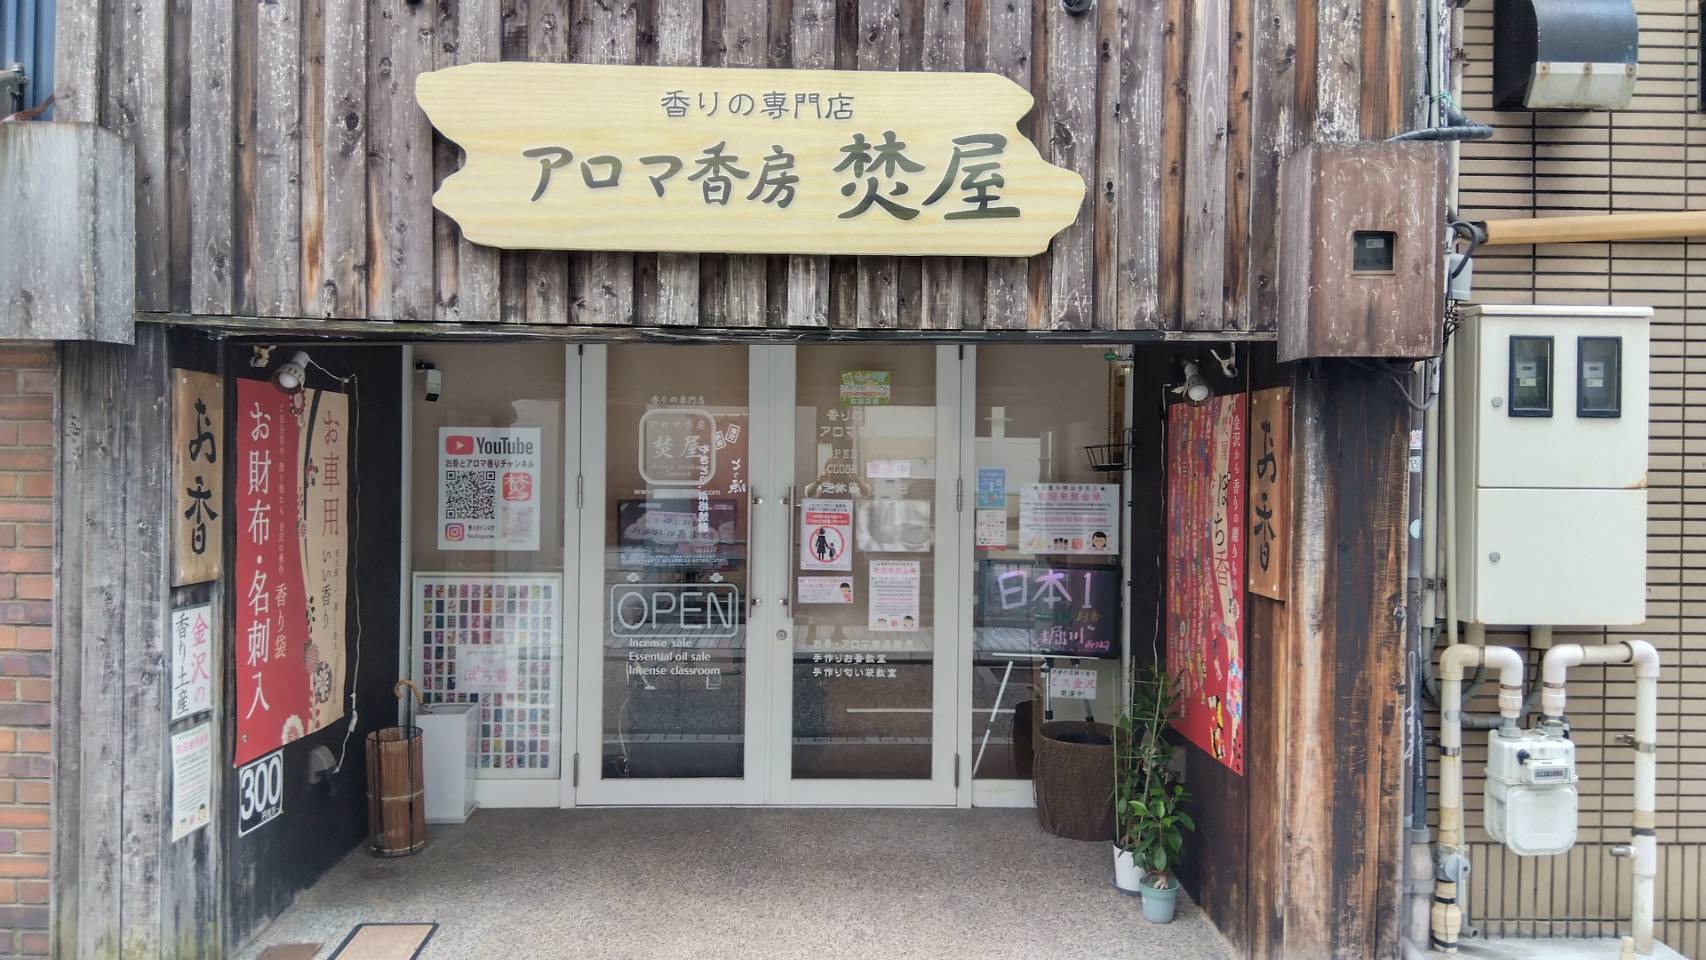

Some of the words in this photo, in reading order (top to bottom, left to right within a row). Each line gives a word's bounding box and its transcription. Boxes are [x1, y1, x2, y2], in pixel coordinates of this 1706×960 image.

[660, 90, 856, 120] 香りの専門店
[522, 141, 797, 209] アロマ香房
[832, 131, 1021, 221] 焚屋
[476, 437, 534, 455] YouTube
[653, 435, 704, 459] 焚屋
[321, 410, 341, 537] お車用
[446, 459, 535, 468] お香とアロマ香りチャンネル
[246, 402, 273, 720] お財布・名刺入
[273, 583, 289, 659] 香り袋
[617, 592, 733, 629] OPEN
[629, 638, 667, 647] Incense
[672, 638, 692, 647] sale
[629, 652, 673, 661] Essential
[675, 652, 688, 661] oil
[691, 652, 711, 661] sale
[174, 612, 191, 716] 香り土産
[629, 666, 667, 675] Incense
[671, 666, 721, 675] classroom
[812, 654, 887, 663] 手作りお香教室
[240, 756, 282, 820] 300
